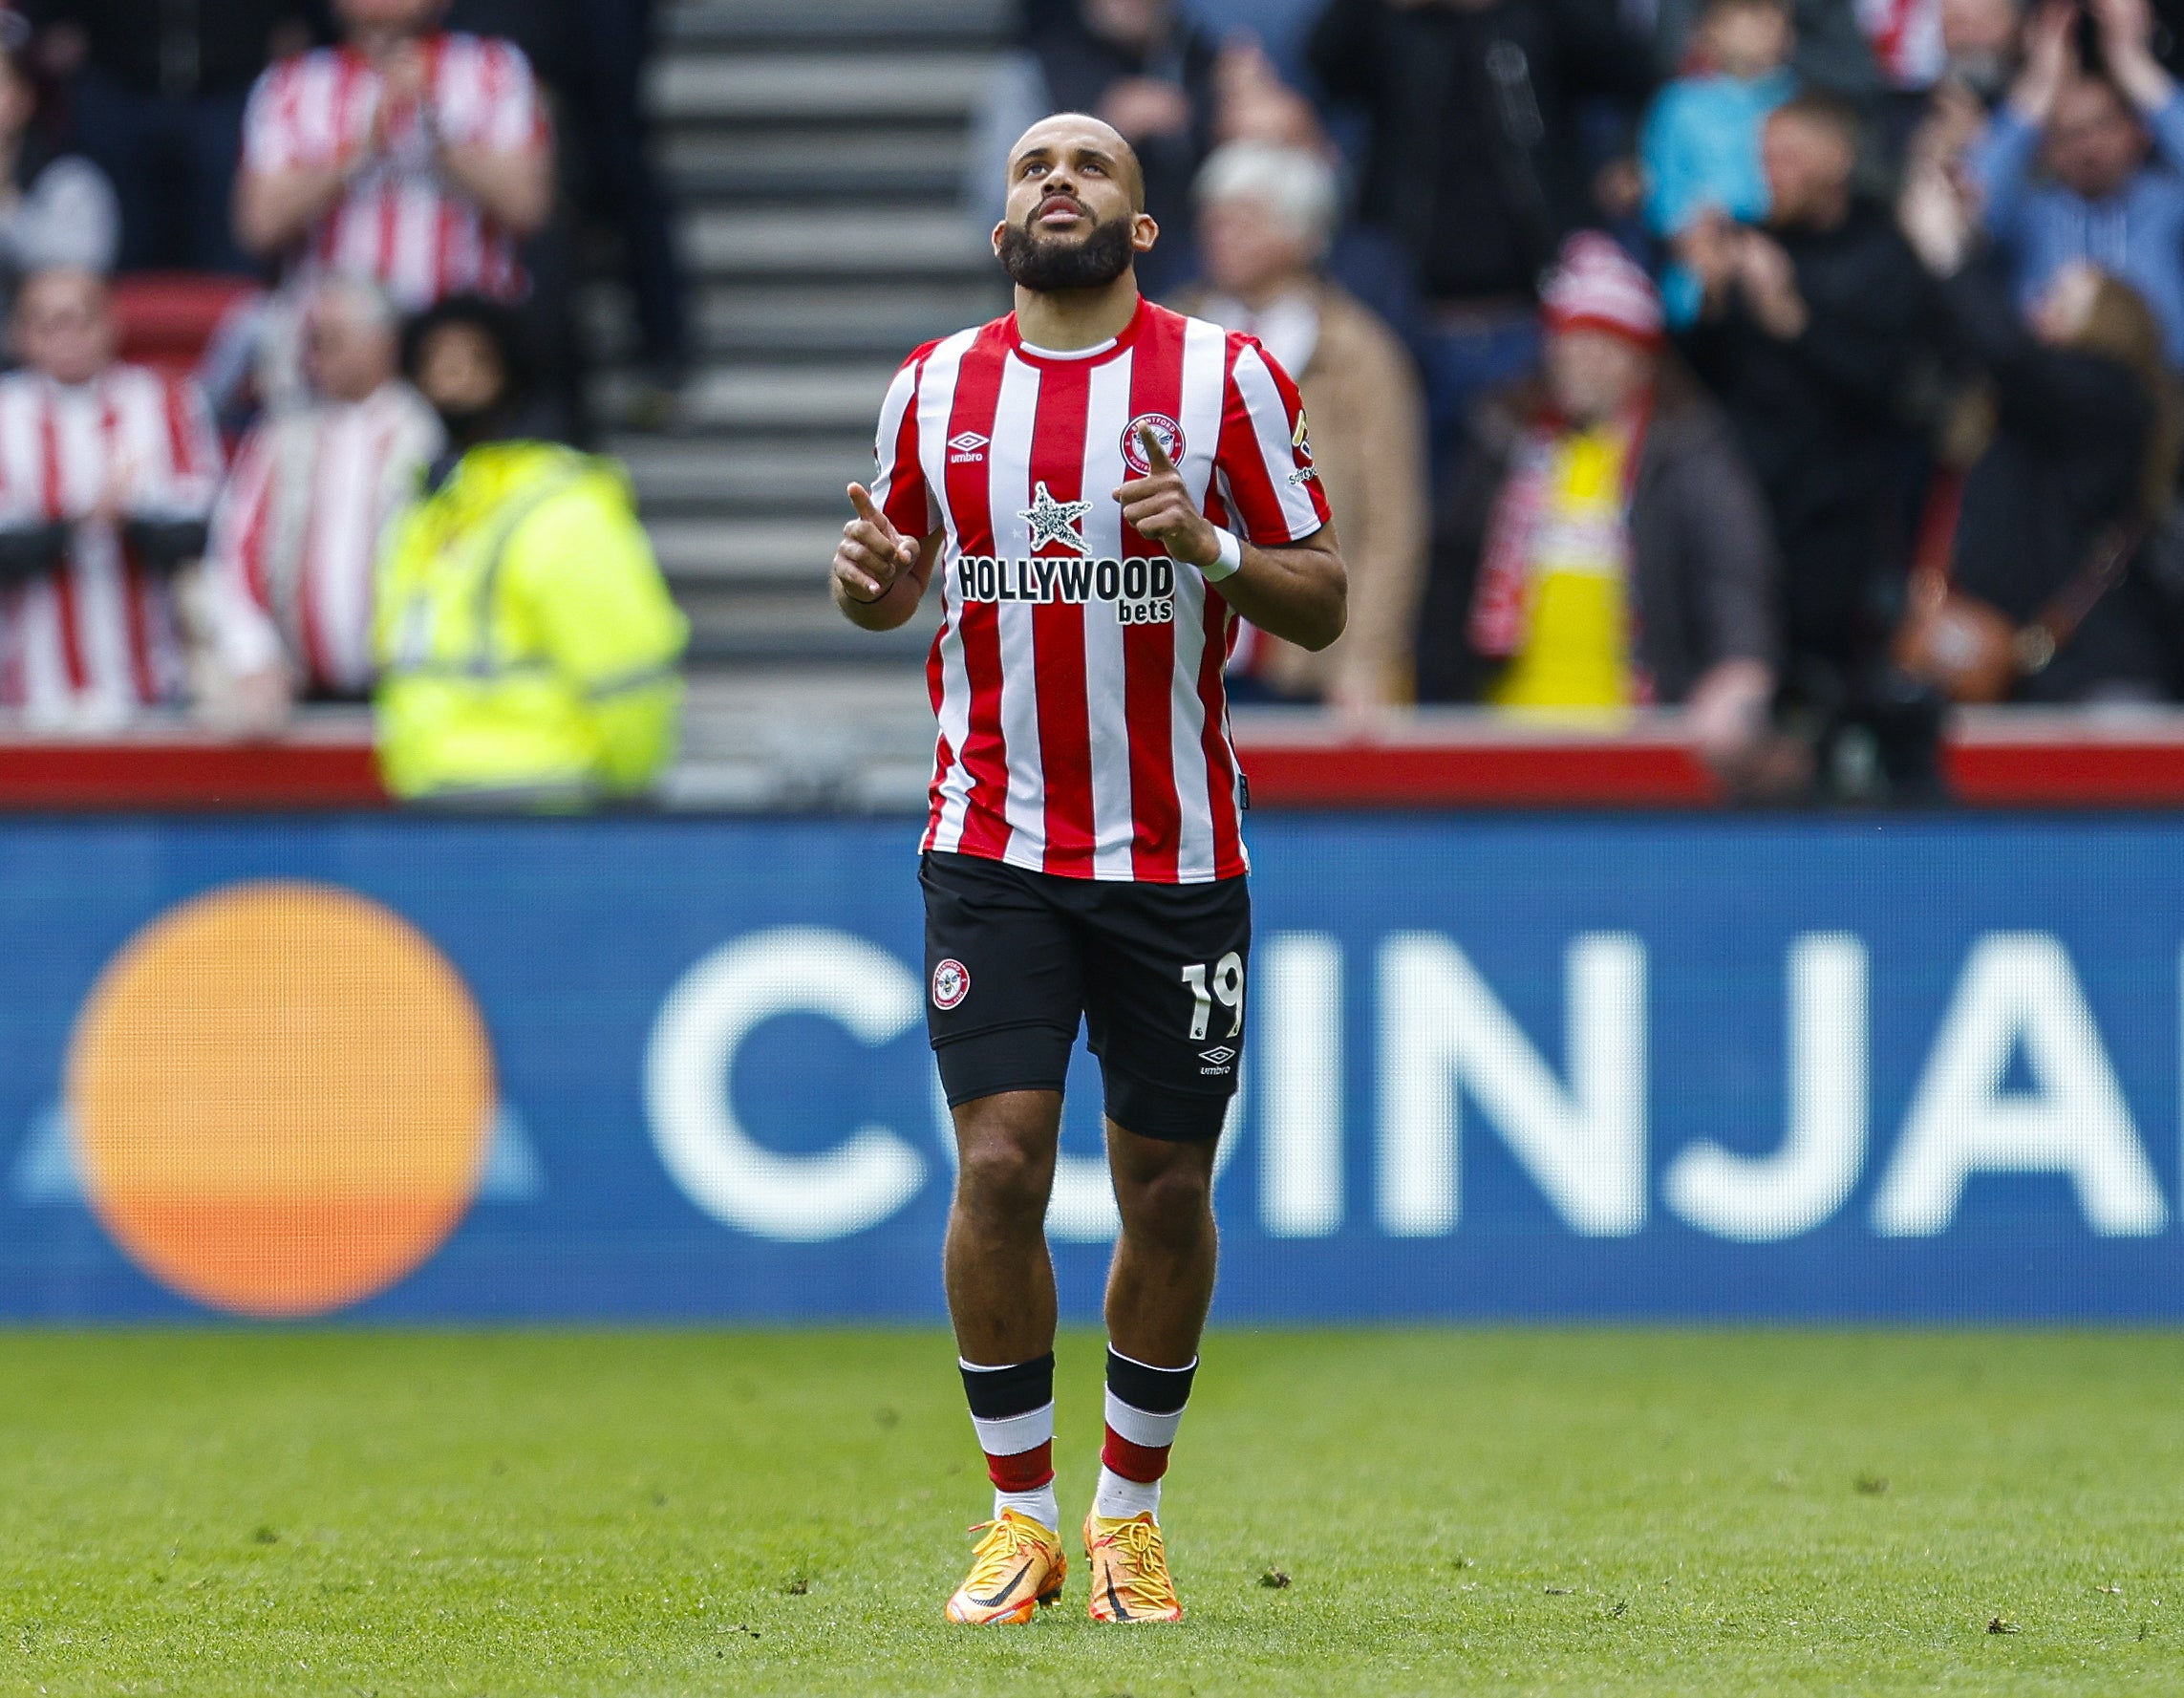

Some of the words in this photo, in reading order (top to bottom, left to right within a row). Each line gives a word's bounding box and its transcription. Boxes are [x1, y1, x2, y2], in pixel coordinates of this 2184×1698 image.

[1131, 417, 1176, 433] BNTFORD
[951, 452, 983, 463] umbro
[957, 557, 1174, 602] HOLLYWOOD
[1118, 599, 1173, 623] bets
[1182, 951, 1244, 1040] 19
[1200, 1065, 1231, 1075] umbro
[642, 924, 2184, 1242] CINJA
